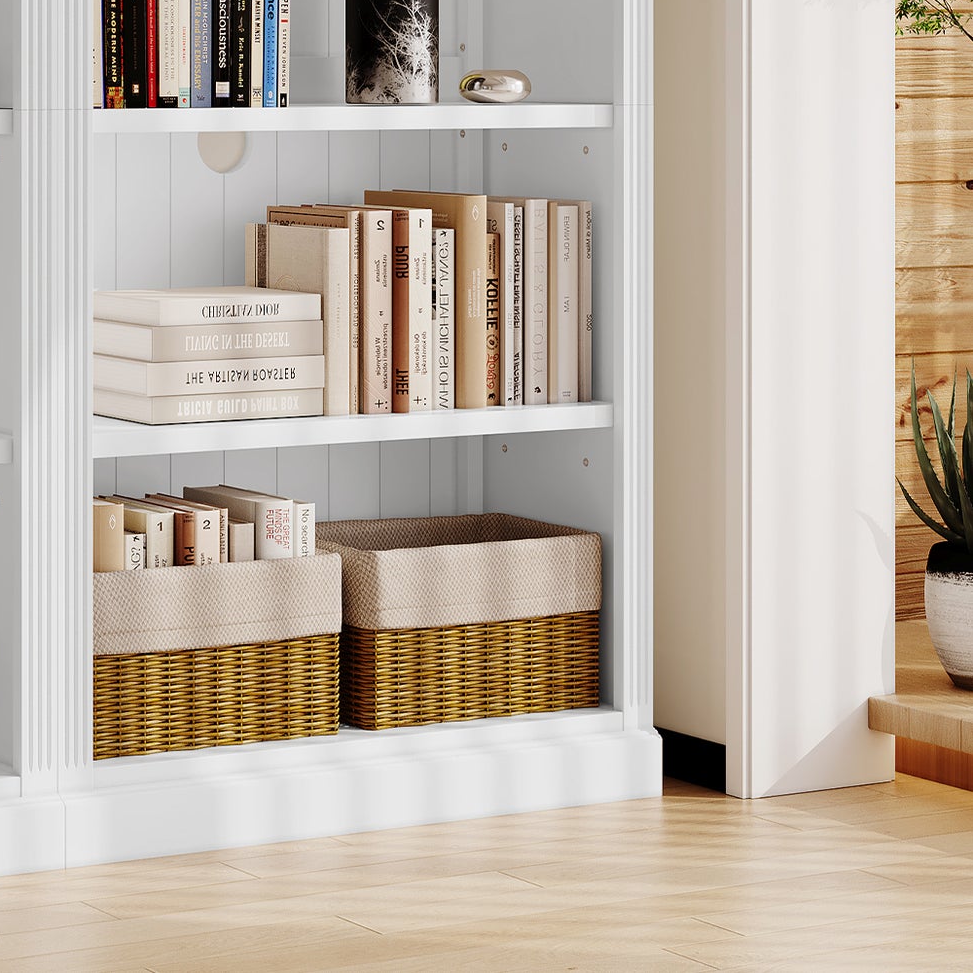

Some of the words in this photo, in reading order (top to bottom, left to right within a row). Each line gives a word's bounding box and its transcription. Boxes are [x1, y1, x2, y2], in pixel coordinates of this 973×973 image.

[302, 508, 310, 523] No
[157, 522, 163, 532] 1
[202, 520, 211, 530] 2
[266, 510, 274, 540] FUTURE
[275, 535, 282, 546] OF
[302, 524, 310, 558] search
